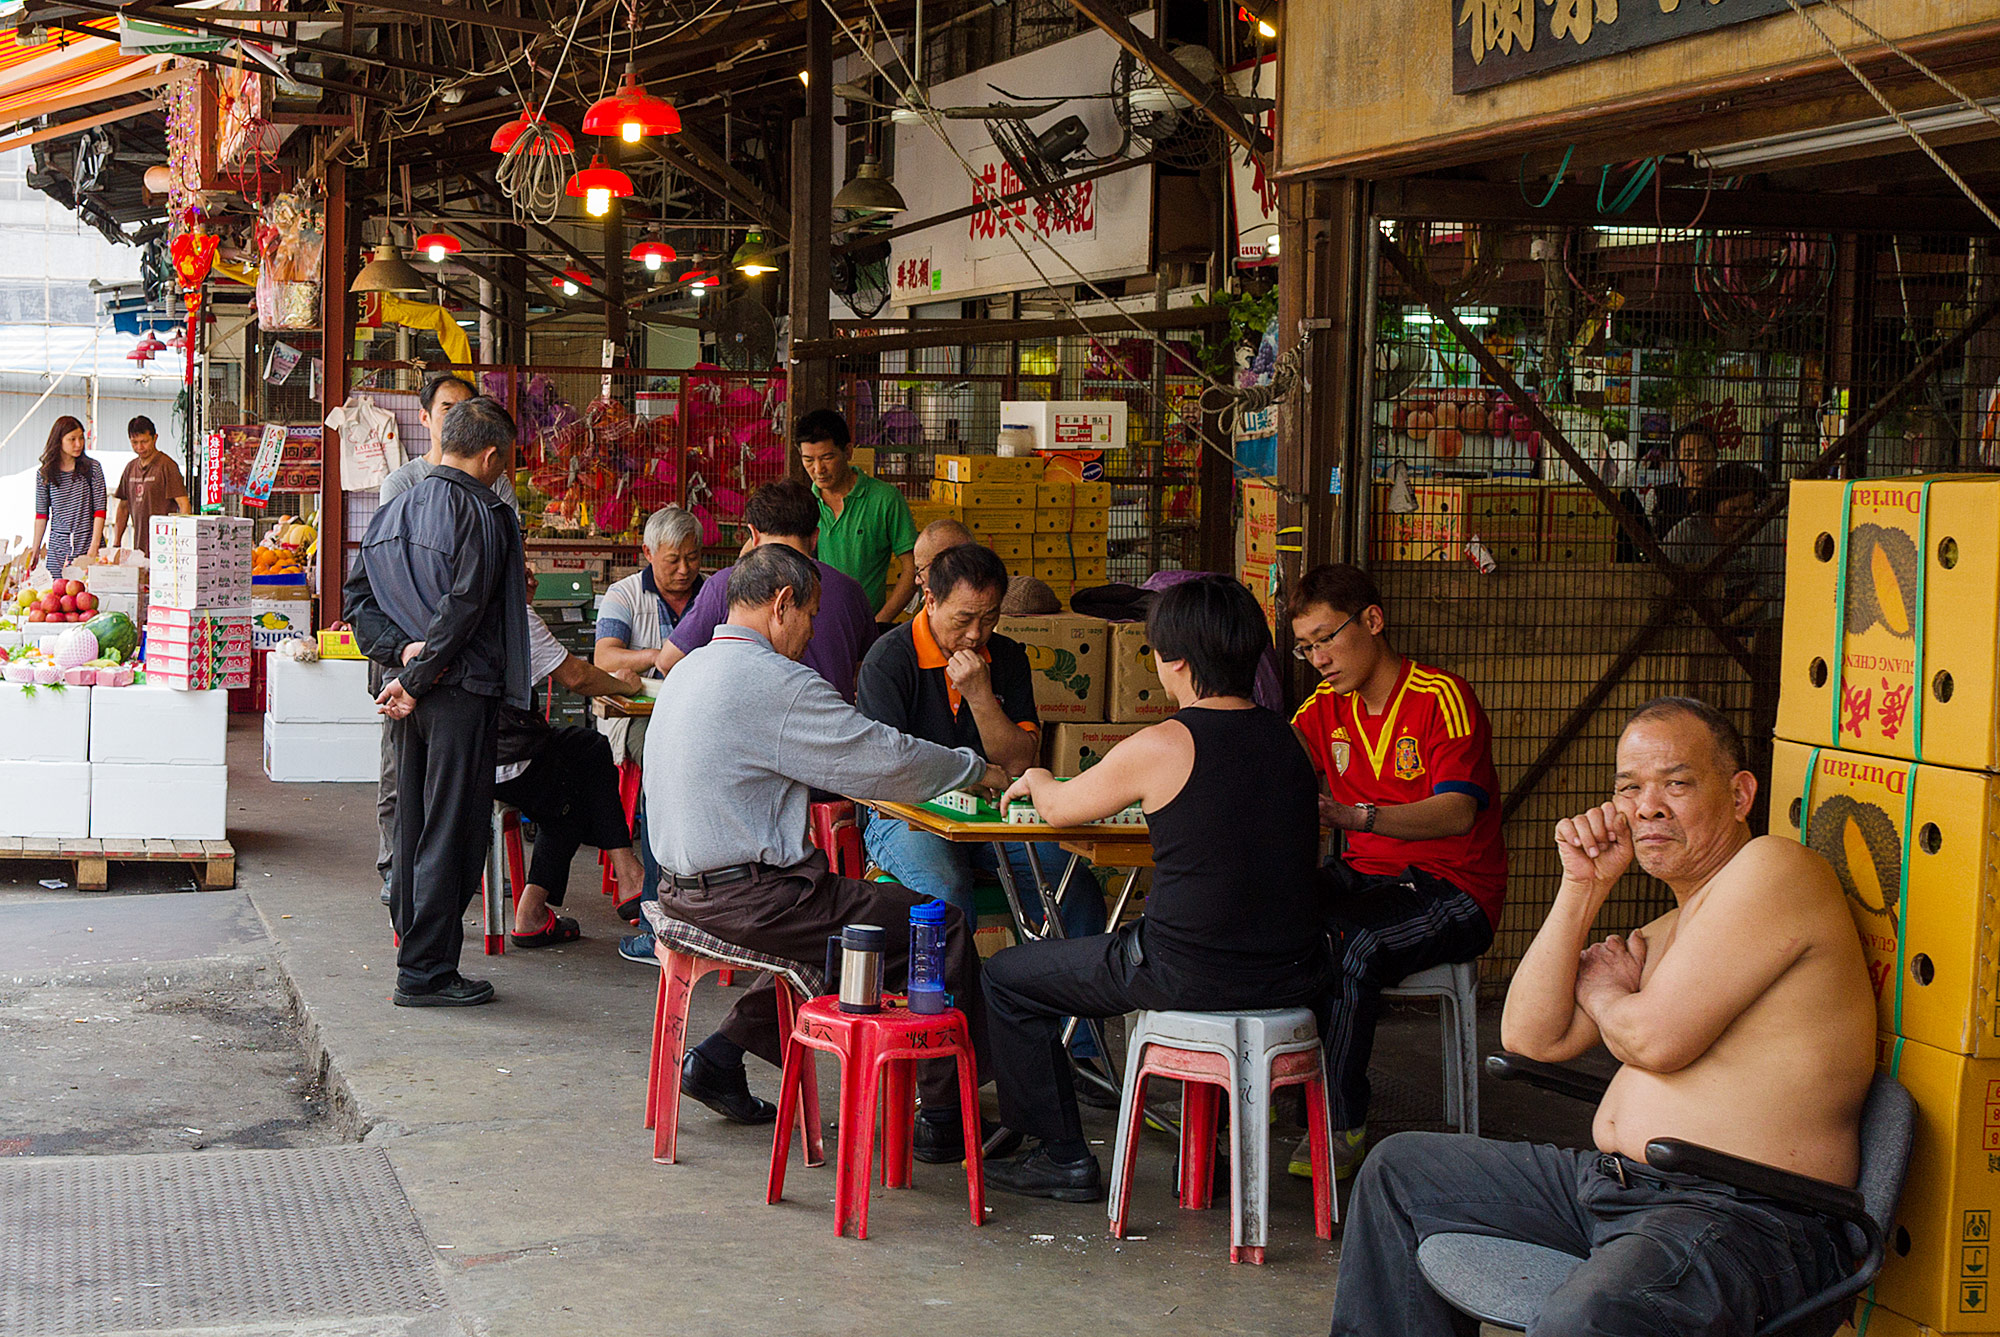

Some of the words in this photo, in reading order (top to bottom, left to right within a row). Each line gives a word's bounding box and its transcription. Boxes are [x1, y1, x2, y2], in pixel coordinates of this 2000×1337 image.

[1039, 703, 1069, 714] Japanese
[1070, 703, 1087, 714] Fresh
[1135, 704, 1163, 715] Pumpkin
[1082, 732, 1099, 742] Fresh
[1823, 758, 1907, 795] Durian
